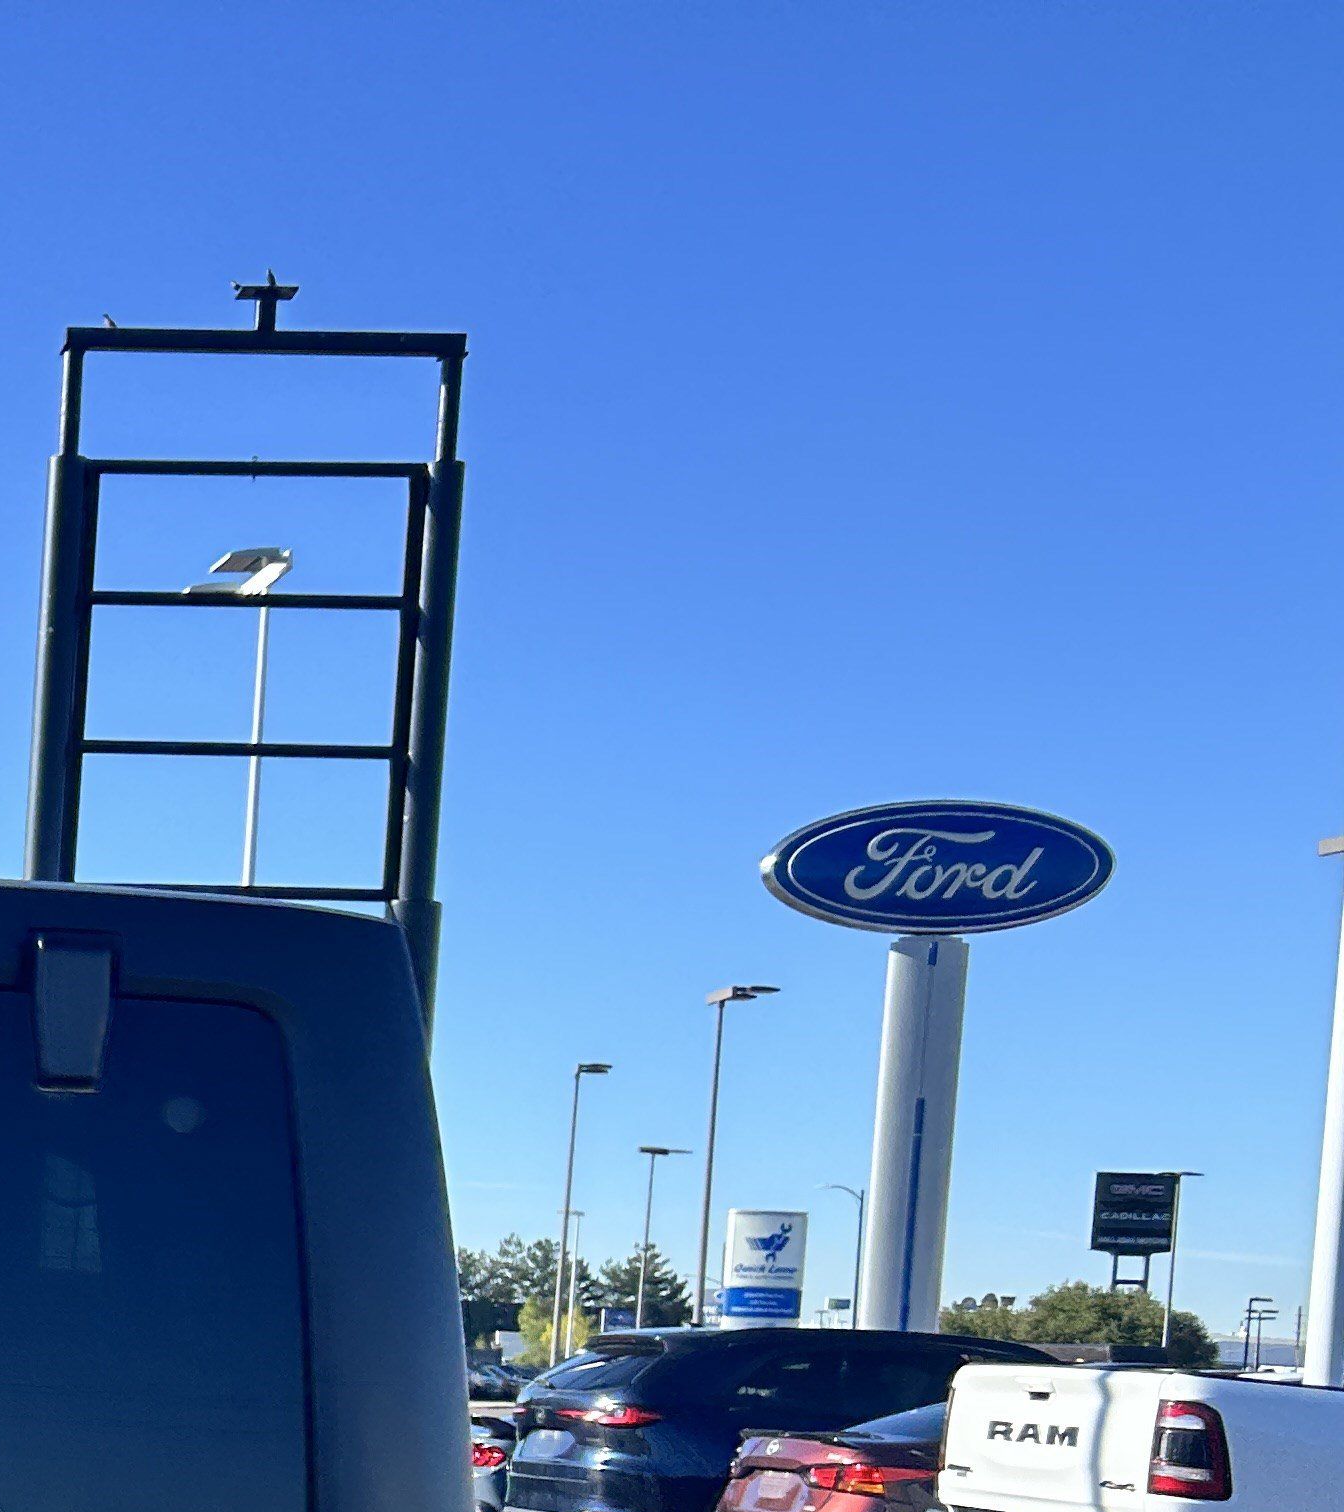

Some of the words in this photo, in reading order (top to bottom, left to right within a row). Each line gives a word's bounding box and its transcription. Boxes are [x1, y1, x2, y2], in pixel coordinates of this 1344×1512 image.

[844, 827, 1045, 901] Ford
[1110, 1184, 1164, 1195] GMC
[1100, 1212, 1171, 1221] CADILLAC
[987, 1420, 1080, 1447] RAM
